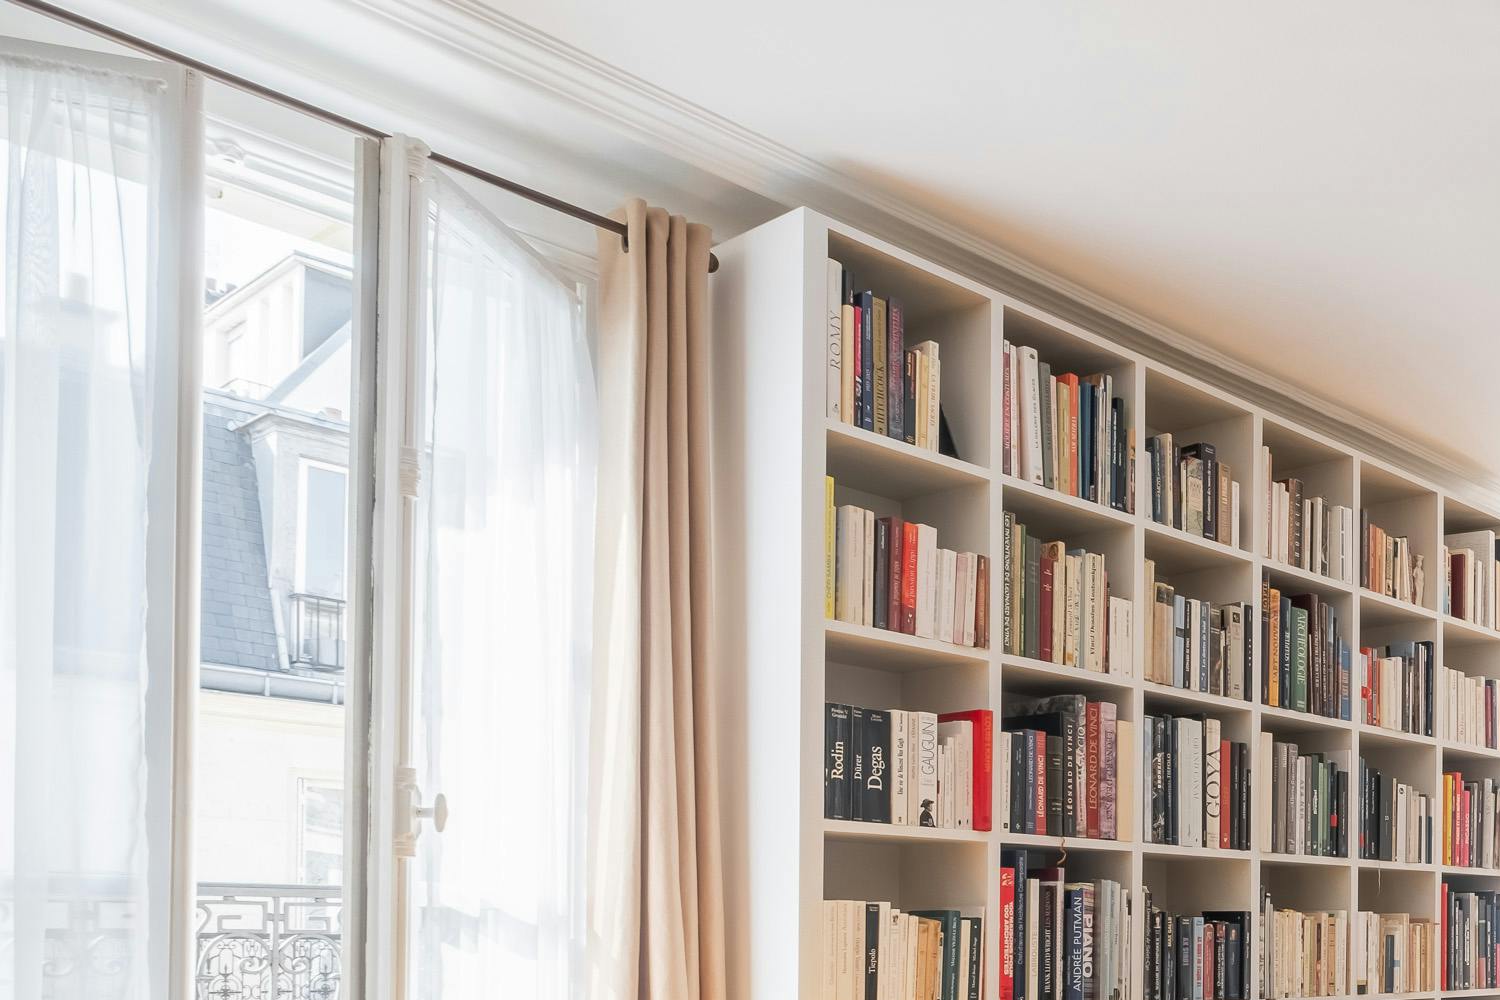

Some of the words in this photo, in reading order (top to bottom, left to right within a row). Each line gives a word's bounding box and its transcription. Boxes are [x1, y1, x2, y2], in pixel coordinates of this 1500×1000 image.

[829, 310, 841, 370] ROMY
[877, 366, 885, 424] HITCHCOCK
[1004, 572, 1010, 581] DE
[831, 741, 844, 780] Rodin
[1067, 755, 1072, 767] DE
[1090, 739, 1097, 753] DE
[854, 754, 862, 780] Dürer
[867, 746, 885, 791] Degas
[1038, 776, 1044, 784] DE
[1206, 749, 1220, 818] GOYA
[1074, 897, 1082, 945] PUTMAN
[868, 948, 877, 974] Tiepolo
[1083, 914, 1093, 977] PIANO
[1072, 949, 1082, 991] ANDRÉE
